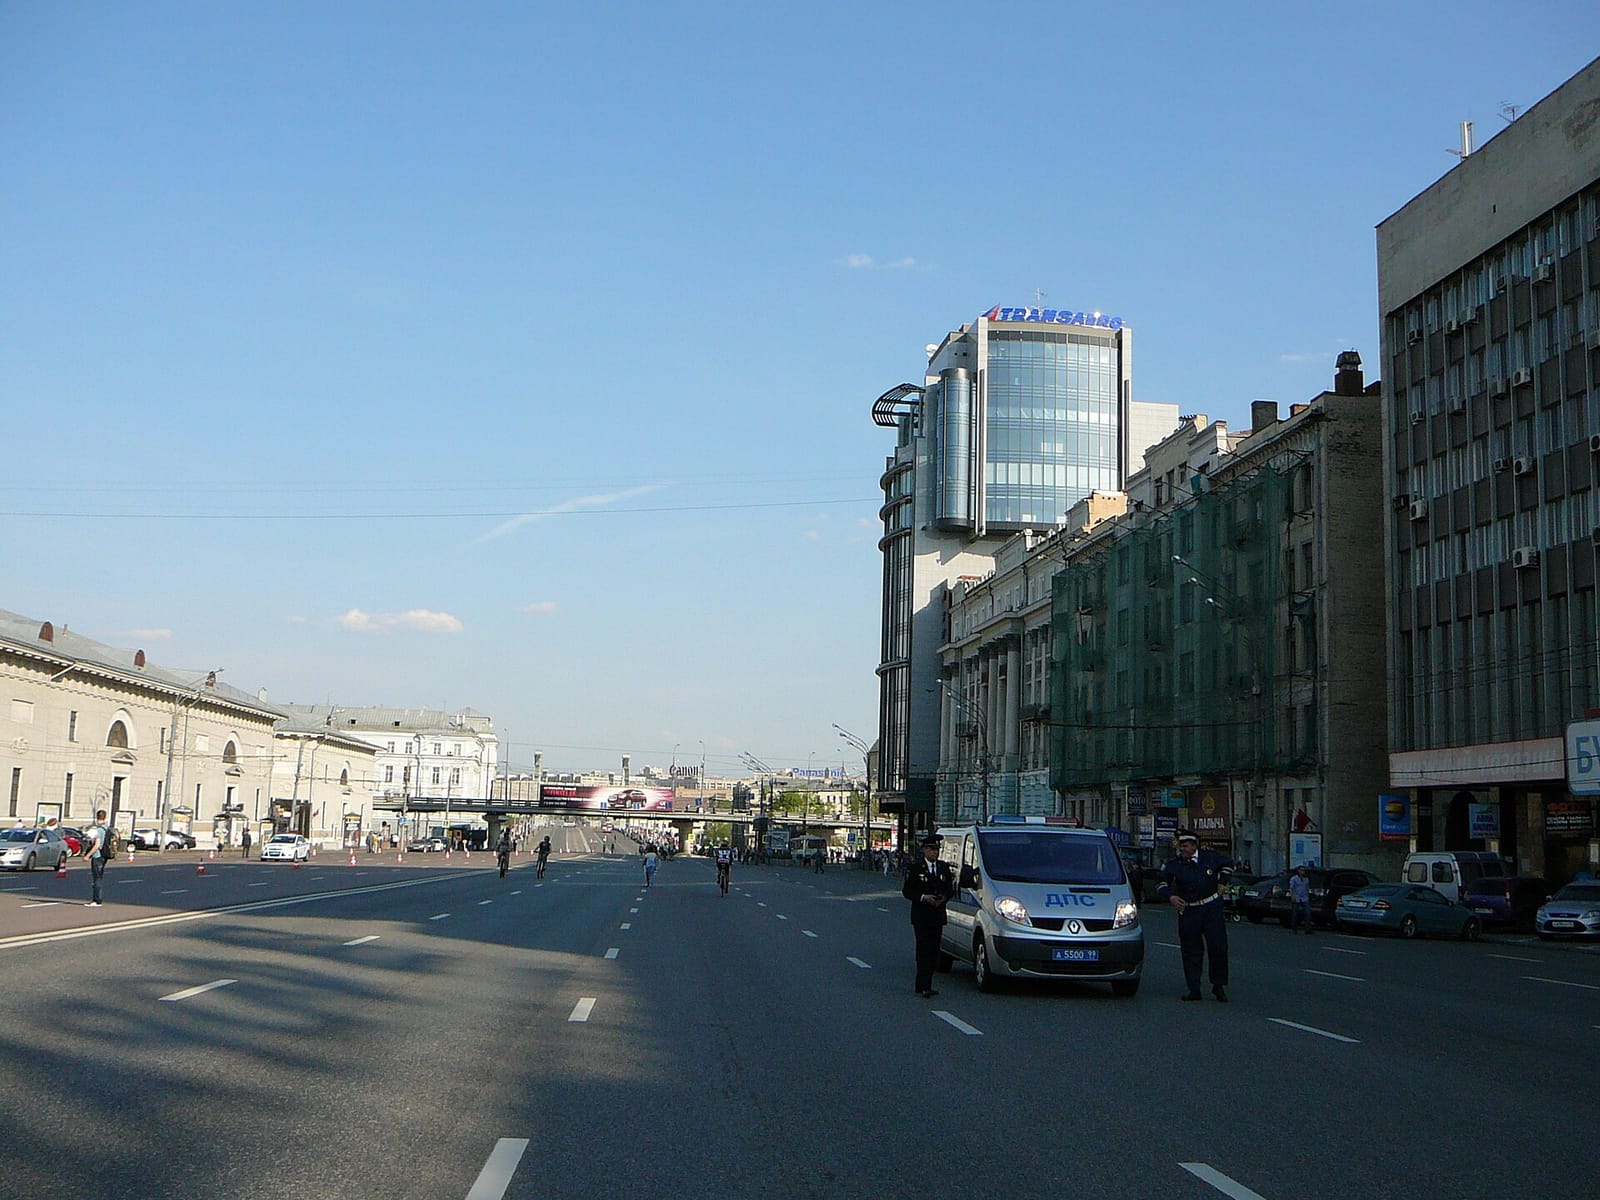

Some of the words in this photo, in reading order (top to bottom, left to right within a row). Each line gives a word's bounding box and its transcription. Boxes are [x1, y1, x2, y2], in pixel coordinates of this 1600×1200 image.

[669, 765, 699, 776] Canon
[792, 767, 847, 777] Panasnic
[1045, 893, 1095, 907] ДПС
[1064, 950, 1084, 959] 5500
